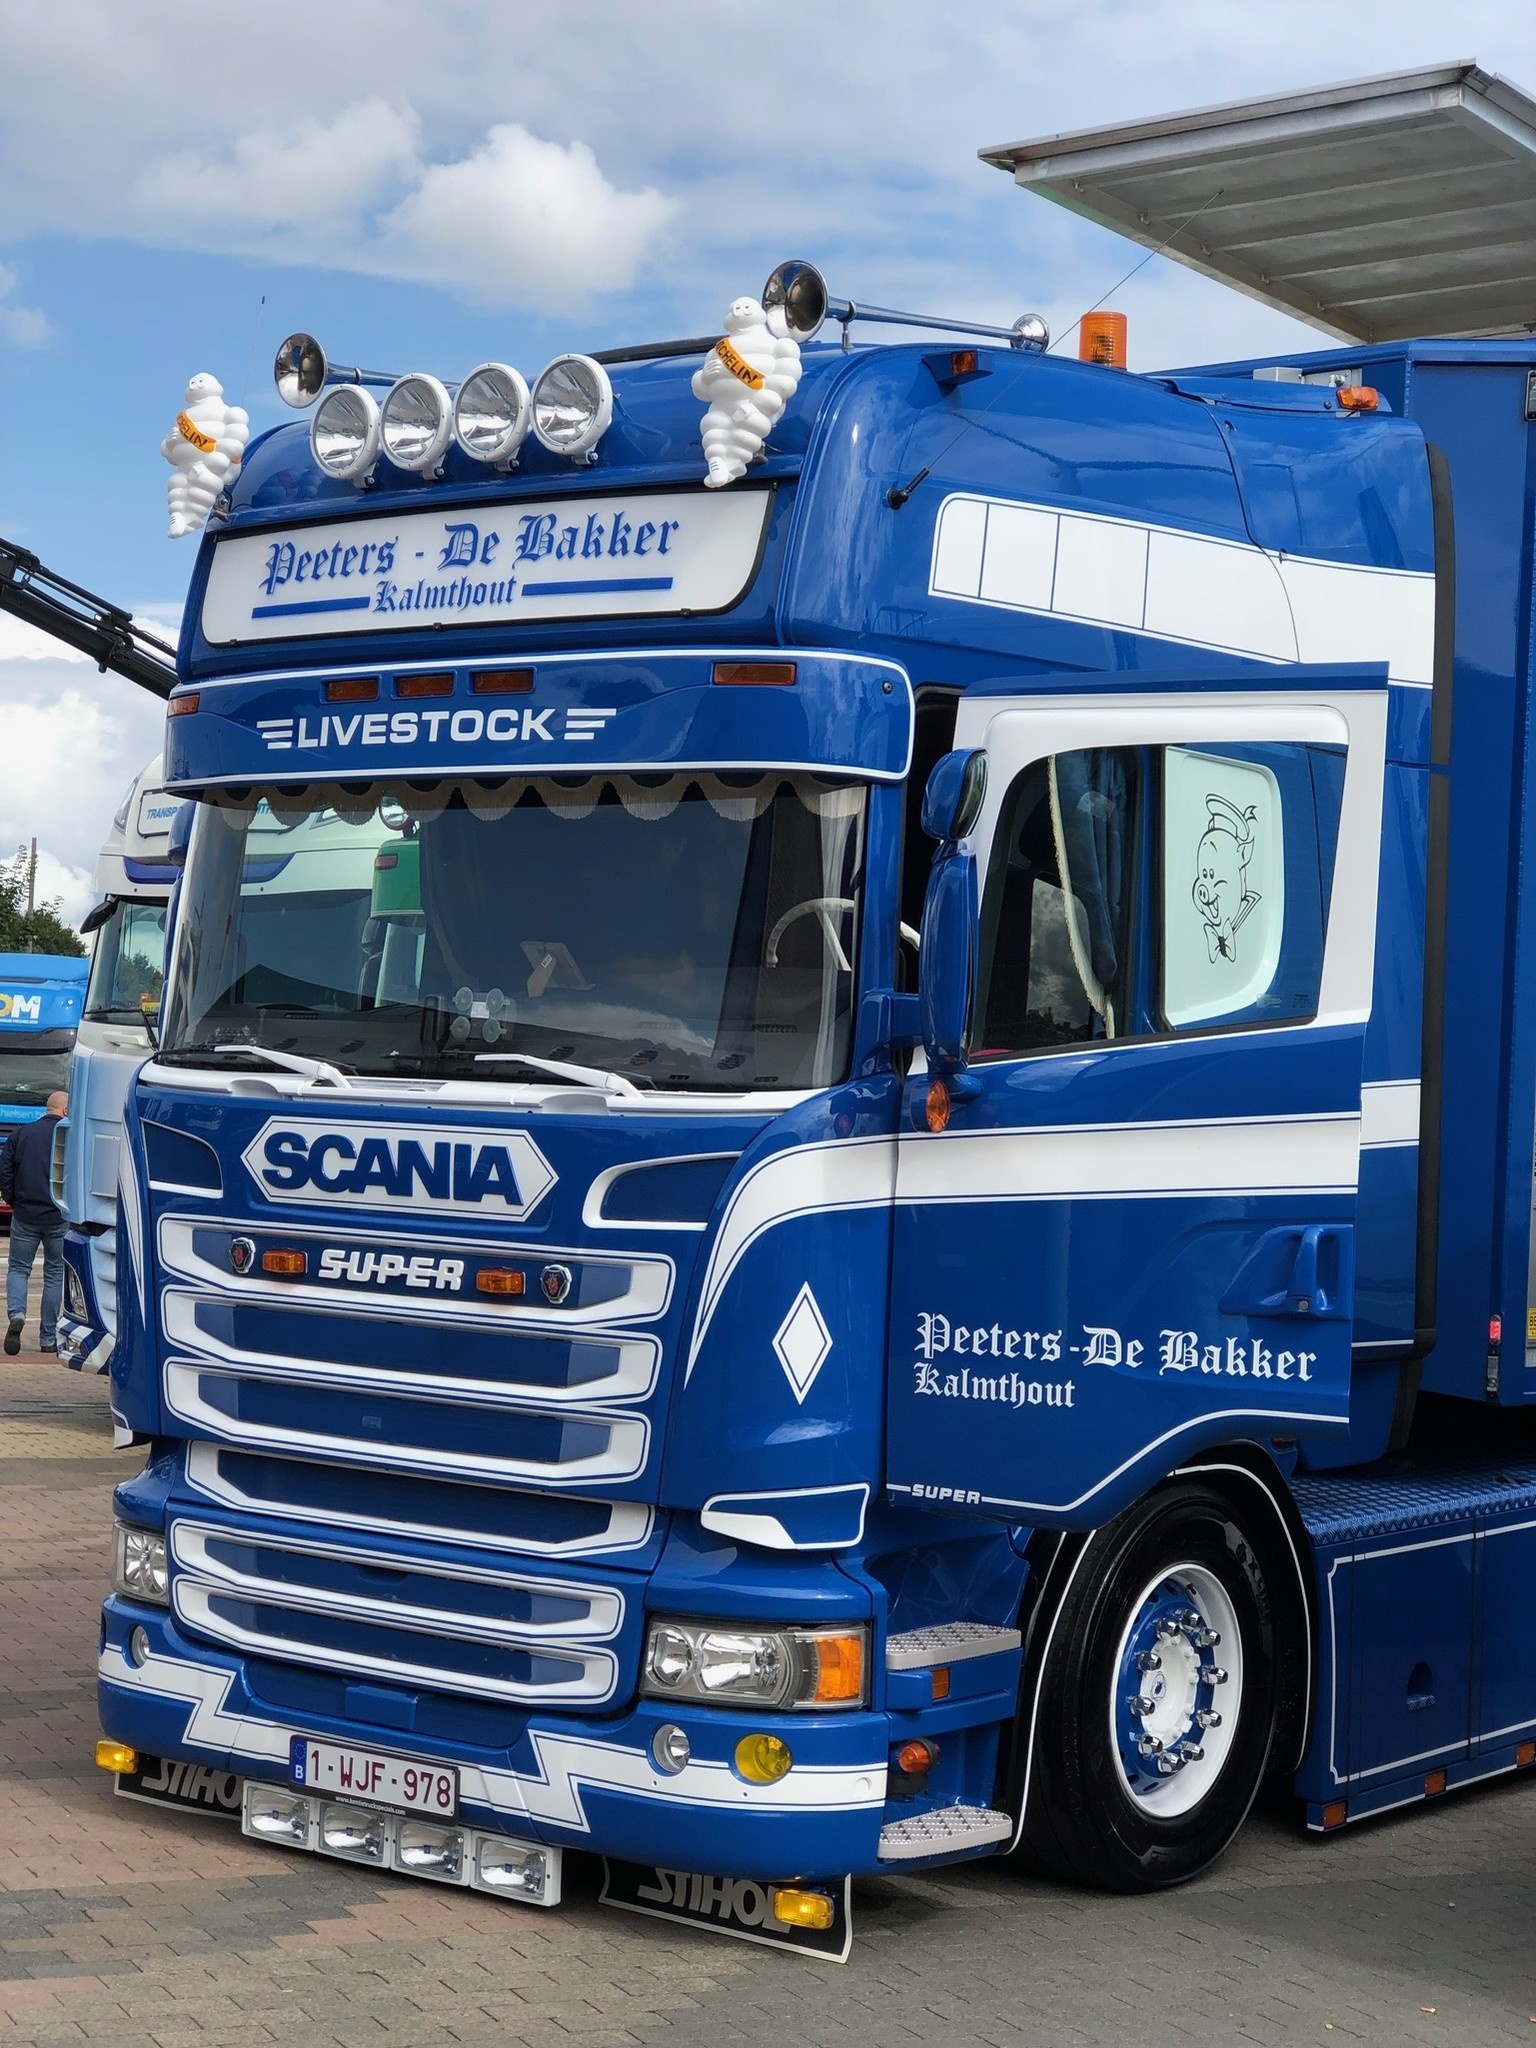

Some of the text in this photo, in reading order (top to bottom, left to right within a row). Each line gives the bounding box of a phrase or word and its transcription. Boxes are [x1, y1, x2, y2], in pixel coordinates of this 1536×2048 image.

[714, 340, 759, 384] ICHELIN
[176, 413, 209, 448] CHELIN
[259, 535, 399, 597] Peeters
[437, 522, 501, 571] De
[511, 512, 680, 570] Bakker
[372, 575, 517, 614] Kalmthout
[297, 708, 556, 748] LIVESTOCK
[146, 806, 178, 820] TRANSP
[262, 1131, 525, 1207] SCANIA
[318, 1248, 465, 1291] SUPER
[914, 1312, 1063, 1362] Peeters
[1158, 1329, 1317, 1382] Bakker
[913, 1361, 1076, 1409] Kalmthout
[911, 1483, 981, 1505] SUPER
[141, 1758, 243, 1809] STIHO
[295, 1764, 304, 1779] B
